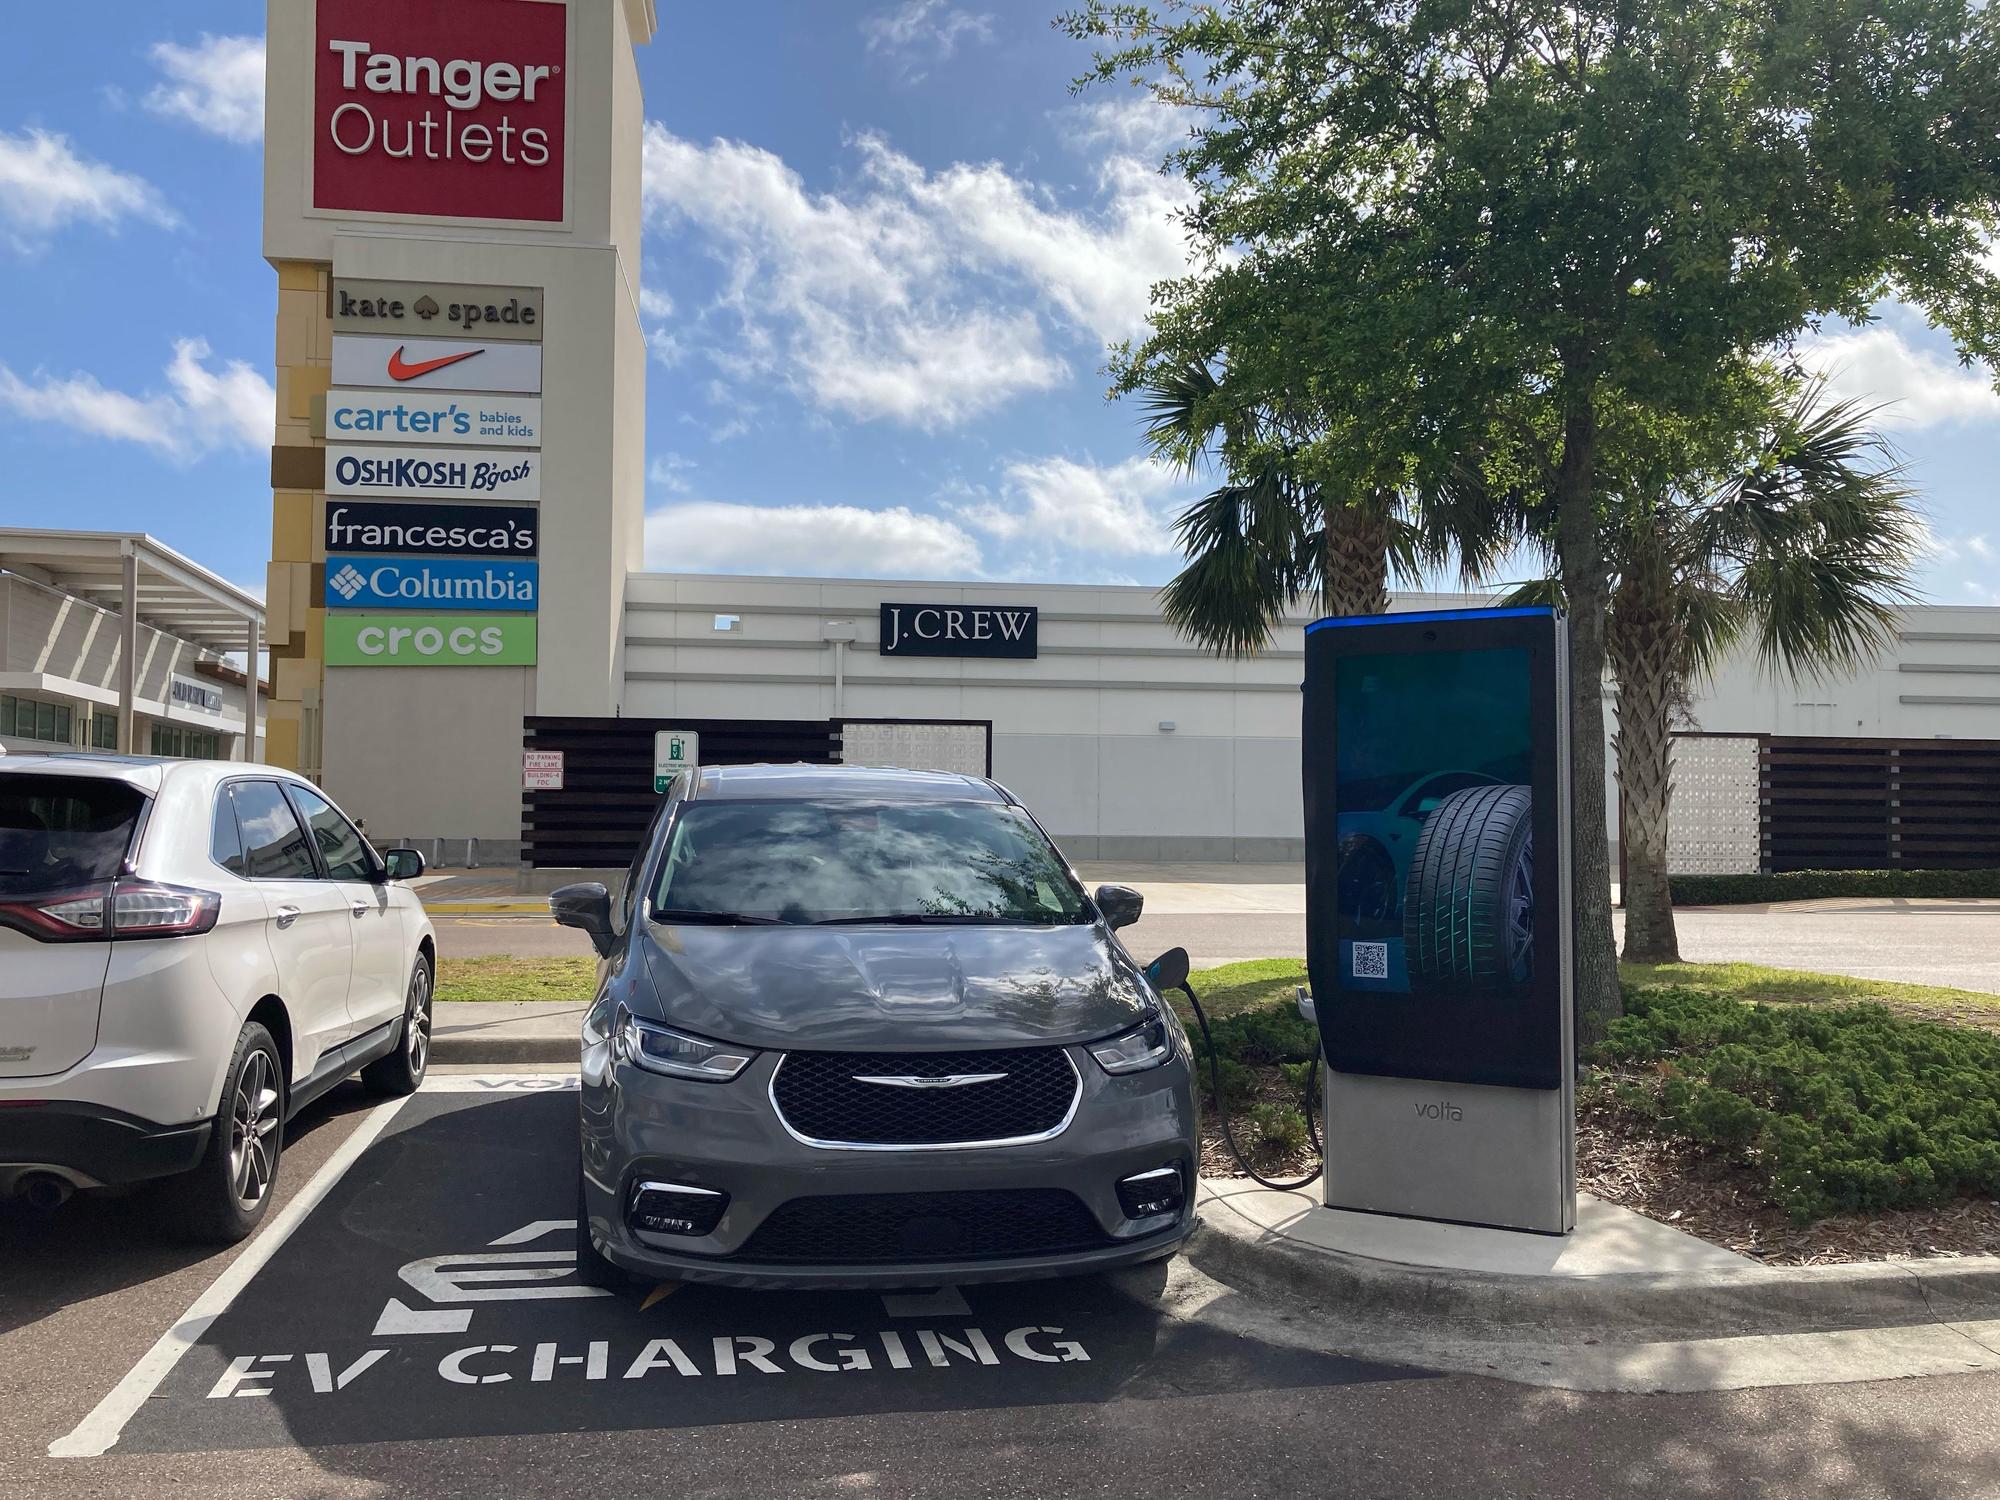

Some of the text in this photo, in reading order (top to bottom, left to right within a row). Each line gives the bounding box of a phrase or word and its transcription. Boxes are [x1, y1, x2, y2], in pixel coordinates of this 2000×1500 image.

[330, 102, 550, 166] Outlets
[338, 290, 536, 330] kate spade
[333, 404, 471, 435] carter's
[480, 410, 522, 423] babies
[480, 424, 534, 437] and kids
[335, 455, 531, 492] OSHKOSH B'gosh
[328, 507, 534, 550] francesca's
[369, 566, 534, 601] Columbia
[356, 625, 504, 656] crocs
[886, 607, 1032, 651] J.CREW
[1413, 1101, 1464, 1122] volta
[206, 1325, 1092, 1399] EV CHARGING
